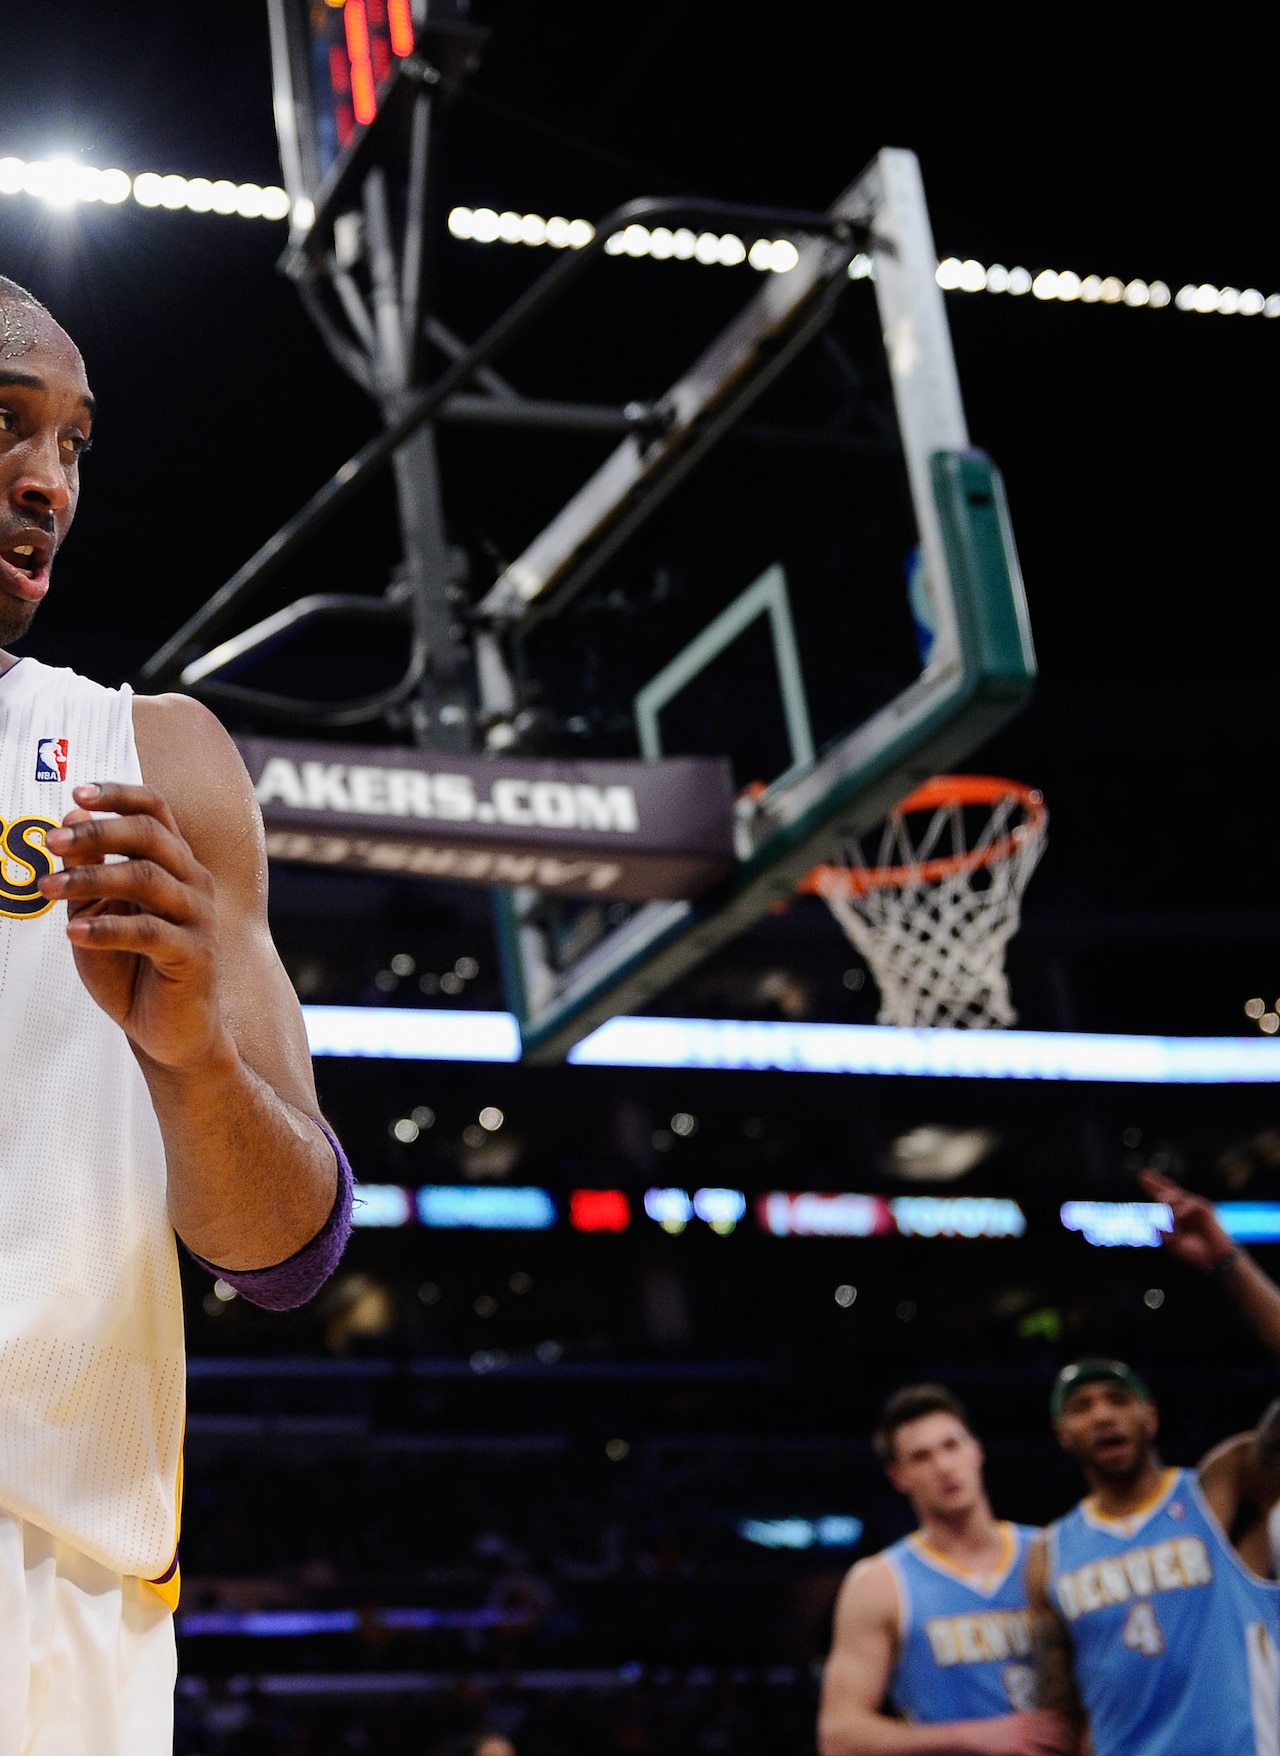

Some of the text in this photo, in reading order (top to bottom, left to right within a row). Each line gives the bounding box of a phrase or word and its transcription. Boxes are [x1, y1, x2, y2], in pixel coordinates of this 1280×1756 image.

[37, 772, 57, 780] NBA
[255, 757, 640, 834] AKERS.COM
[1057, 1535, 1213, 1622] DENVER
[926, 1610, 1034, 1667] DENV
[1123, 1601, 1164, 1658] 4
